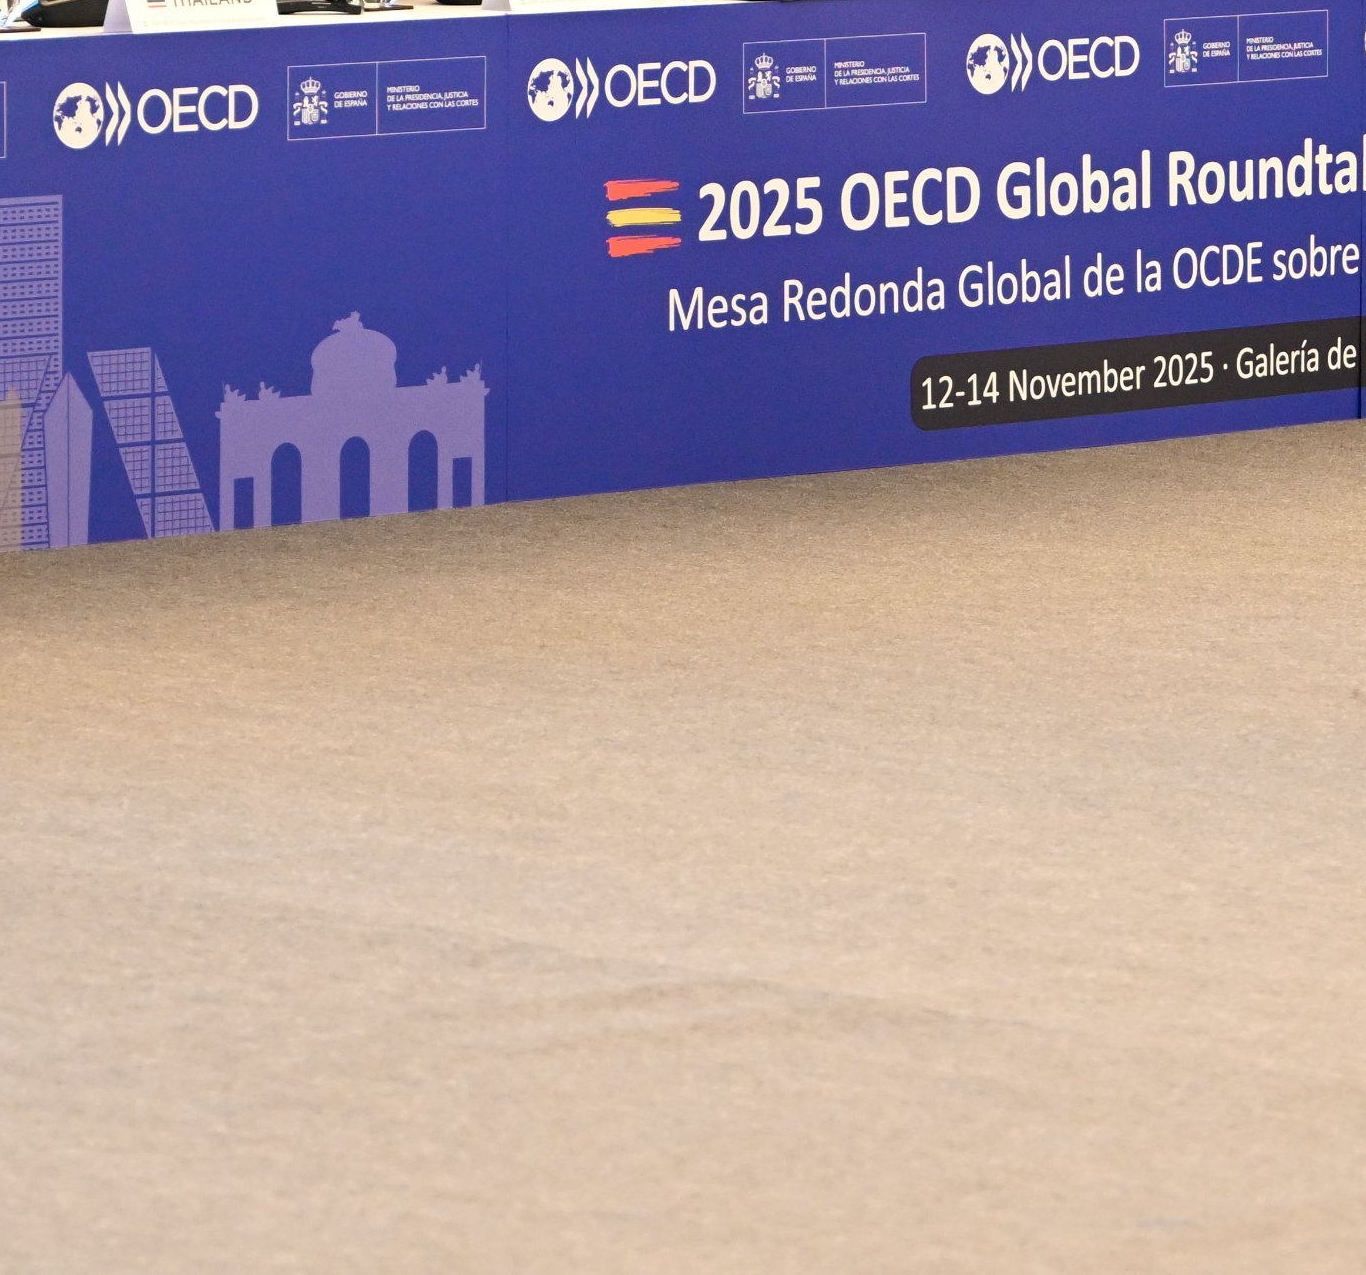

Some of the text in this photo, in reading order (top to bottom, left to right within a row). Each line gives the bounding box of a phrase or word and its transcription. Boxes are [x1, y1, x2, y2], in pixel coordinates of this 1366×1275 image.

[1038, 36, 1140, 81] OECD
[786, 66, 816, 74] GOBIERNO
[605, 60, 716, 107] OECD
[795, 74, 816, 82] ESPAÑA
[839, 77, 872, 85] RELACIONES
[334, 91, 367, 99] GOBIERNO
[396, 94, 403, 102] LA
[443, 91, 468, 99] JUSTICIA
[137, 85, 258, 134] OECD
[334, 99, 367, 108] DE ESPAÑA
[392, 102, 427, 111] RELACIONES
[456, 99, 478, 107] CORTES
[699, 177, 822, 241] 2025
[841, 167, 980, 230] OECD
[997, 150, 1150, 219] Global
[670, 287, 767, 330] Mesa
[784, 267, 944, 321] Redonda
[959, 255, 1069, 307] Global
[1084, 252, 1123, 296] de
[1137, 249, 1161, 292] la
[1173, 242, 1262, 288] OCDE
[1273, 235, 1359, 280] sobre
[922, 372, 999, 409] 12-14
[1009, 359, 1145, 401] November
[1154, 351, 1213, 387] 2025
[1237, 340, 1318, 378] Galería
[1328, 337, 1355, 369] de
